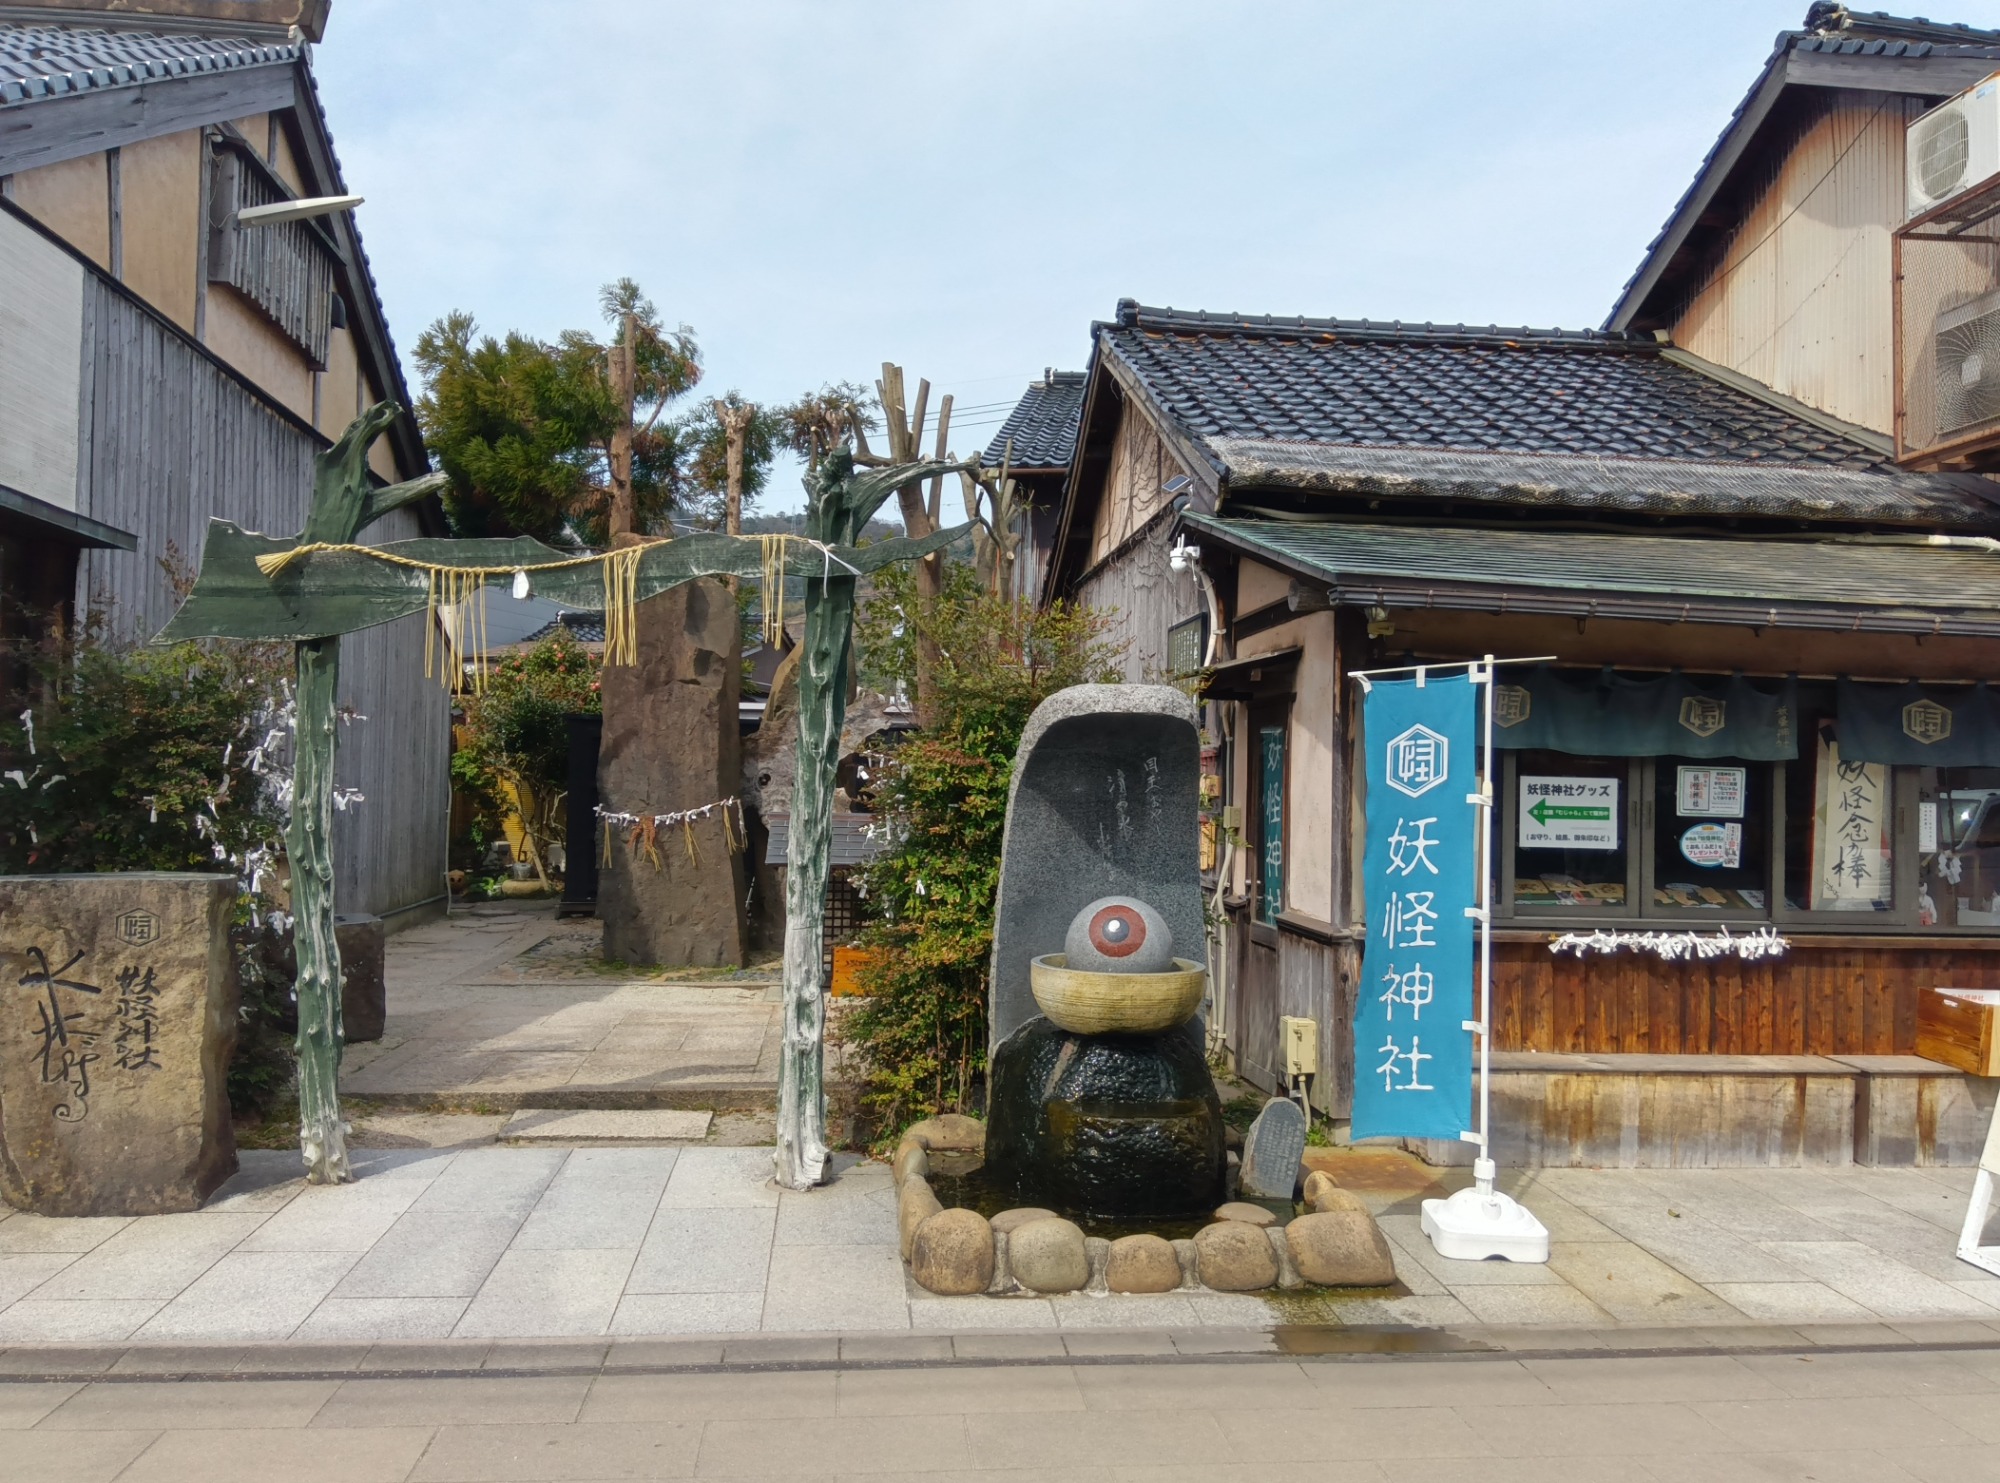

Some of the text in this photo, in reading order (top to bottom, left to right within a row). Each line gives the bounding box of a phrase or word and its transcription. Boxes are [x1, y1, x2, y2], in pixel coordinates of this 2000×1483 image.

[1527, 783, 1611, 797] 妖怪神社グッズ
[1376, 816, 1440, 1093] 妖怪神社
[112, 965, 162, 1071] 妖怪神社
